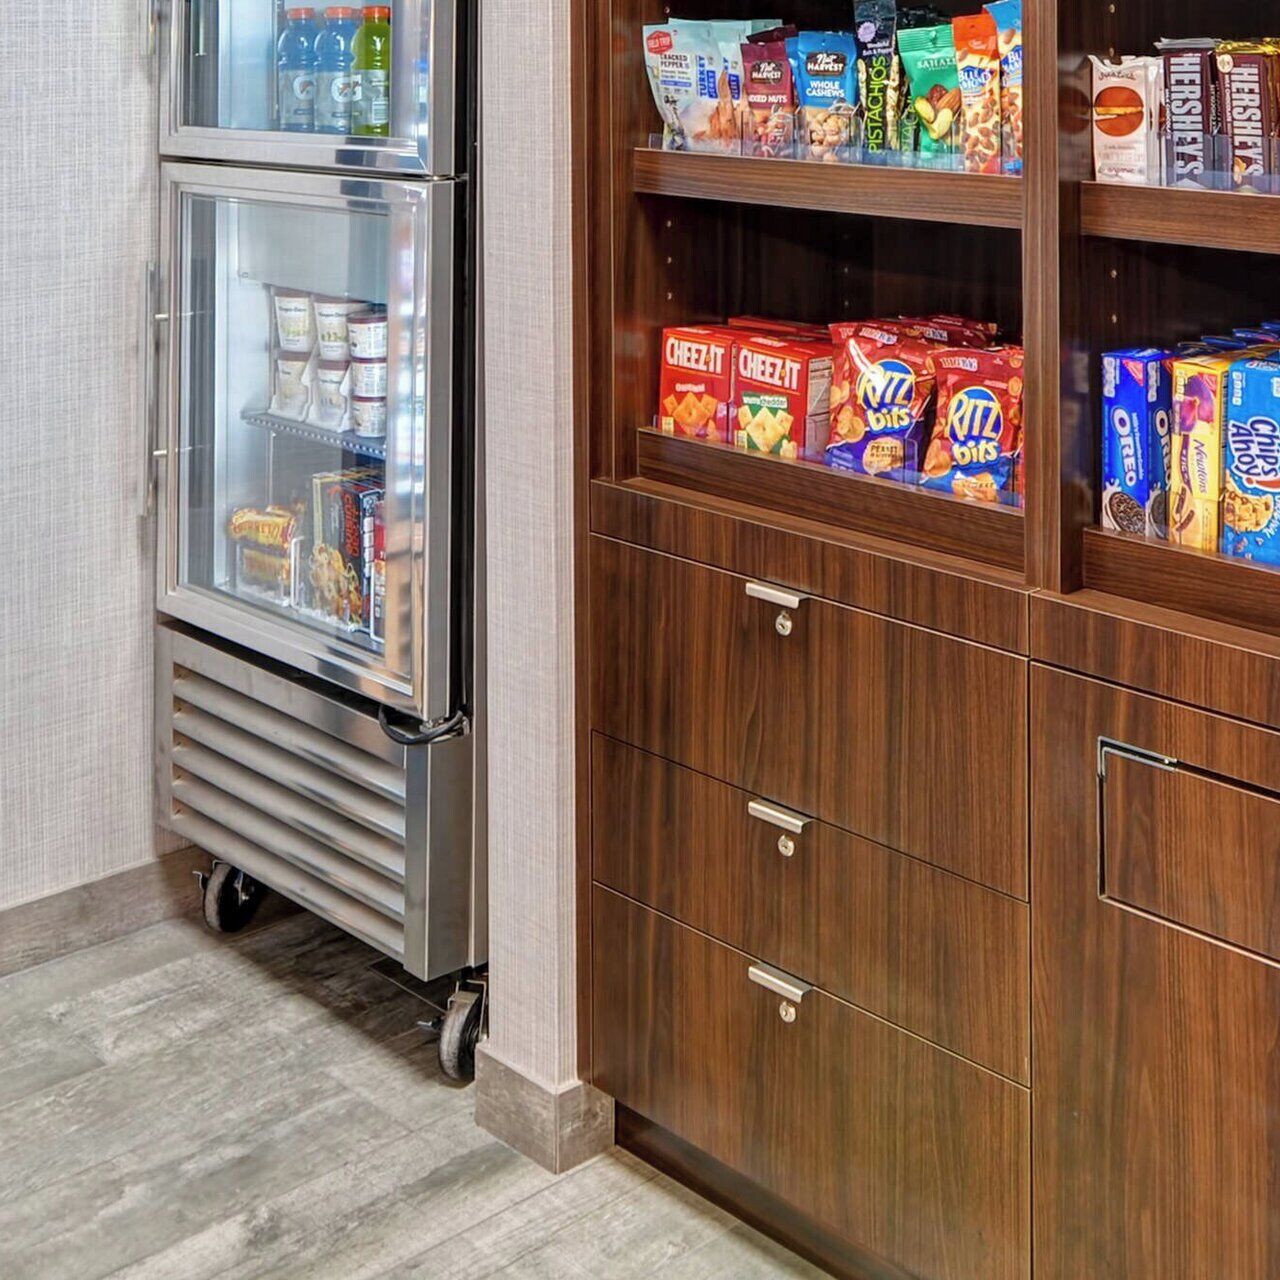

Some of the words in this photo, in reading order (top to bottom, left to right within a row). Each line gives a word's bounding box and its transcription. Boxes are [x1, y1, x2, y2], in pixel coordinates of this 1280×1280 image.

[660, 61, 683, 69] PEPPER
[759, 61, 776, 71] Nut
[807, 61, 844, 72] HARVEST
[817, 51, 837, 65] Nut
[699, 55, 707, 98] TURKEY
[810, 80, 840, 90] WHOLE
[769, 94, 787, 103] NUTS
[805, 87, 845, 98] CASHEWS
[867, 55, 888, 153] PISTACHIOS
[1170, 57, 1205, 175] HERSHEY'S
[1231, 67, 1265, 177] HERSHEY'S
[867, 405, 911, 432] bits
[948, 392, 1001, 441] RITZ
[951, 439, 1000, 465] bits
[1111, 408, 1137, 487] OREO
[1249, 417, 1280, 478] Chips
[1193, 438, 1208, 494] Newtons
